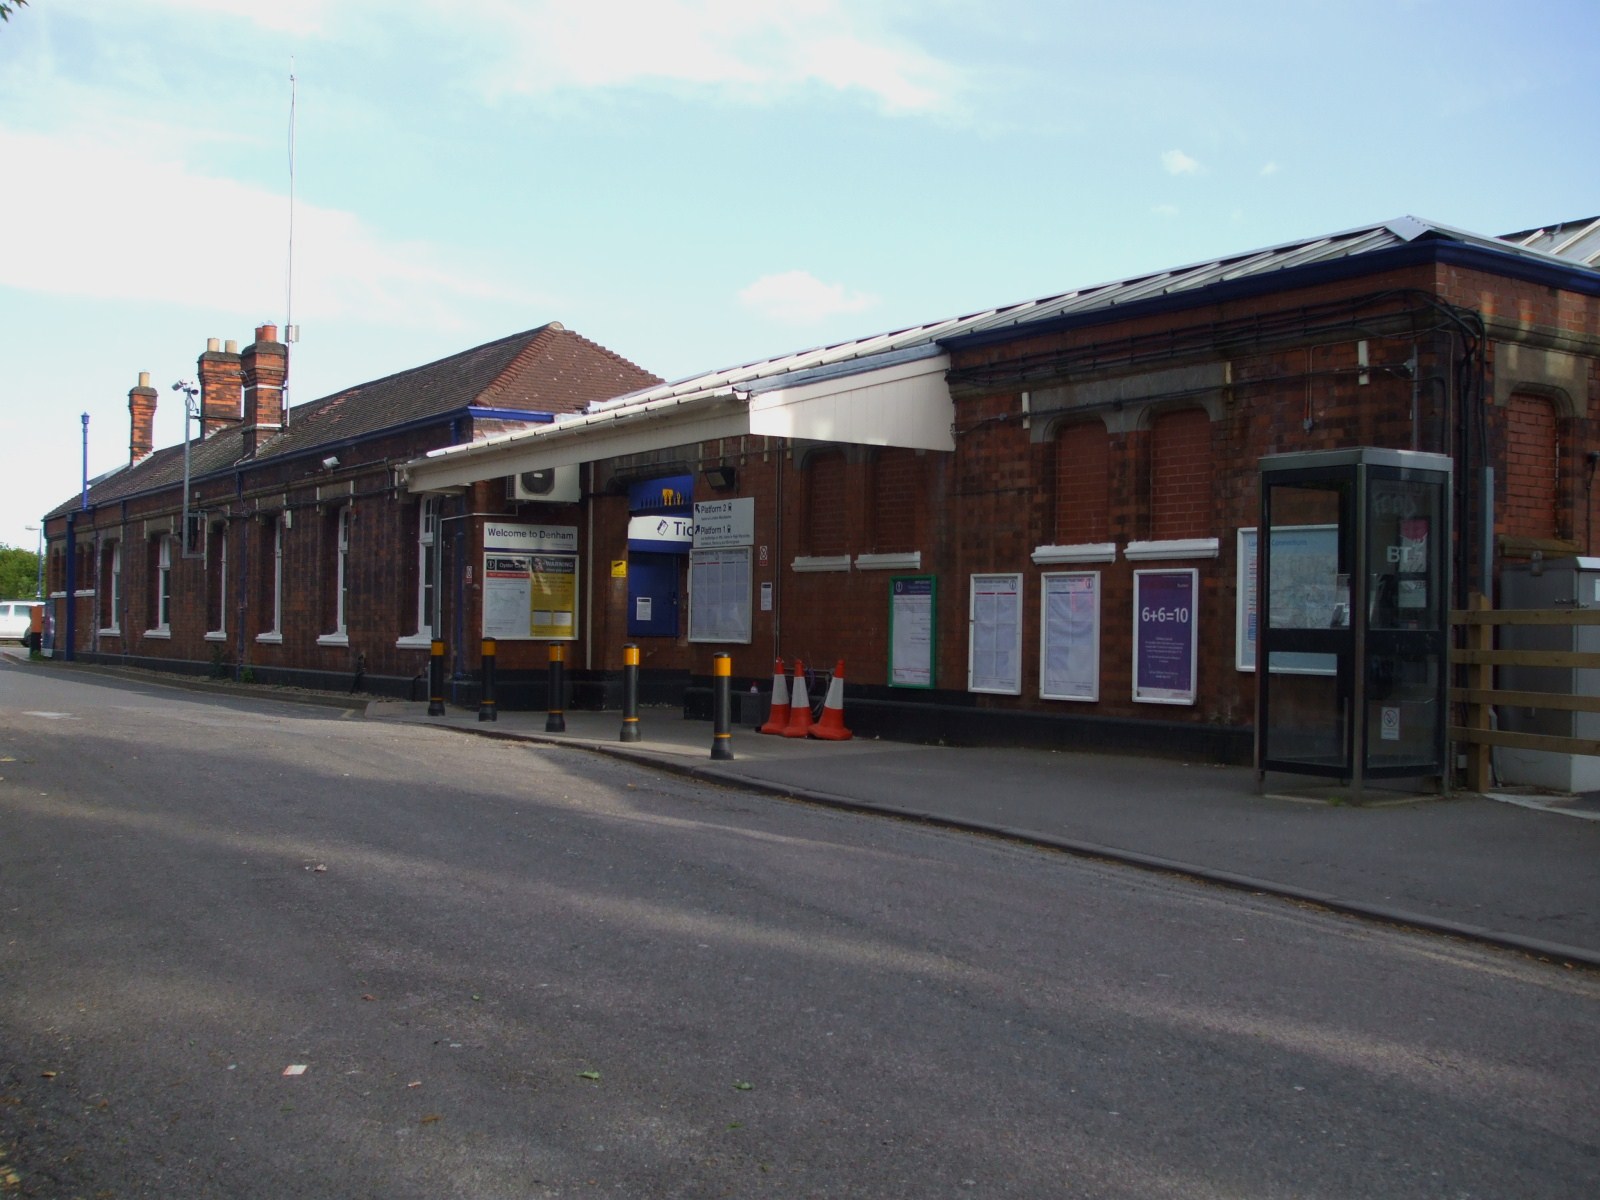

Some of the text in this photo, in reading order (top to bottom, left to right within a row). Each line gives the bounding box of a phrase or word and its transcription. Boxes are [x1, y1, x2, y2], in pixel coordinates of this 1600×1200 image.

[701, 504, 727, 514] Platform 2
[488, 528, 574, 540] Welcome to Denham
[701, 526, 722, 535] Platform
[1387, 546, 1412, 563] BT
[1142, 606, 1189, 623] 6+6=10
